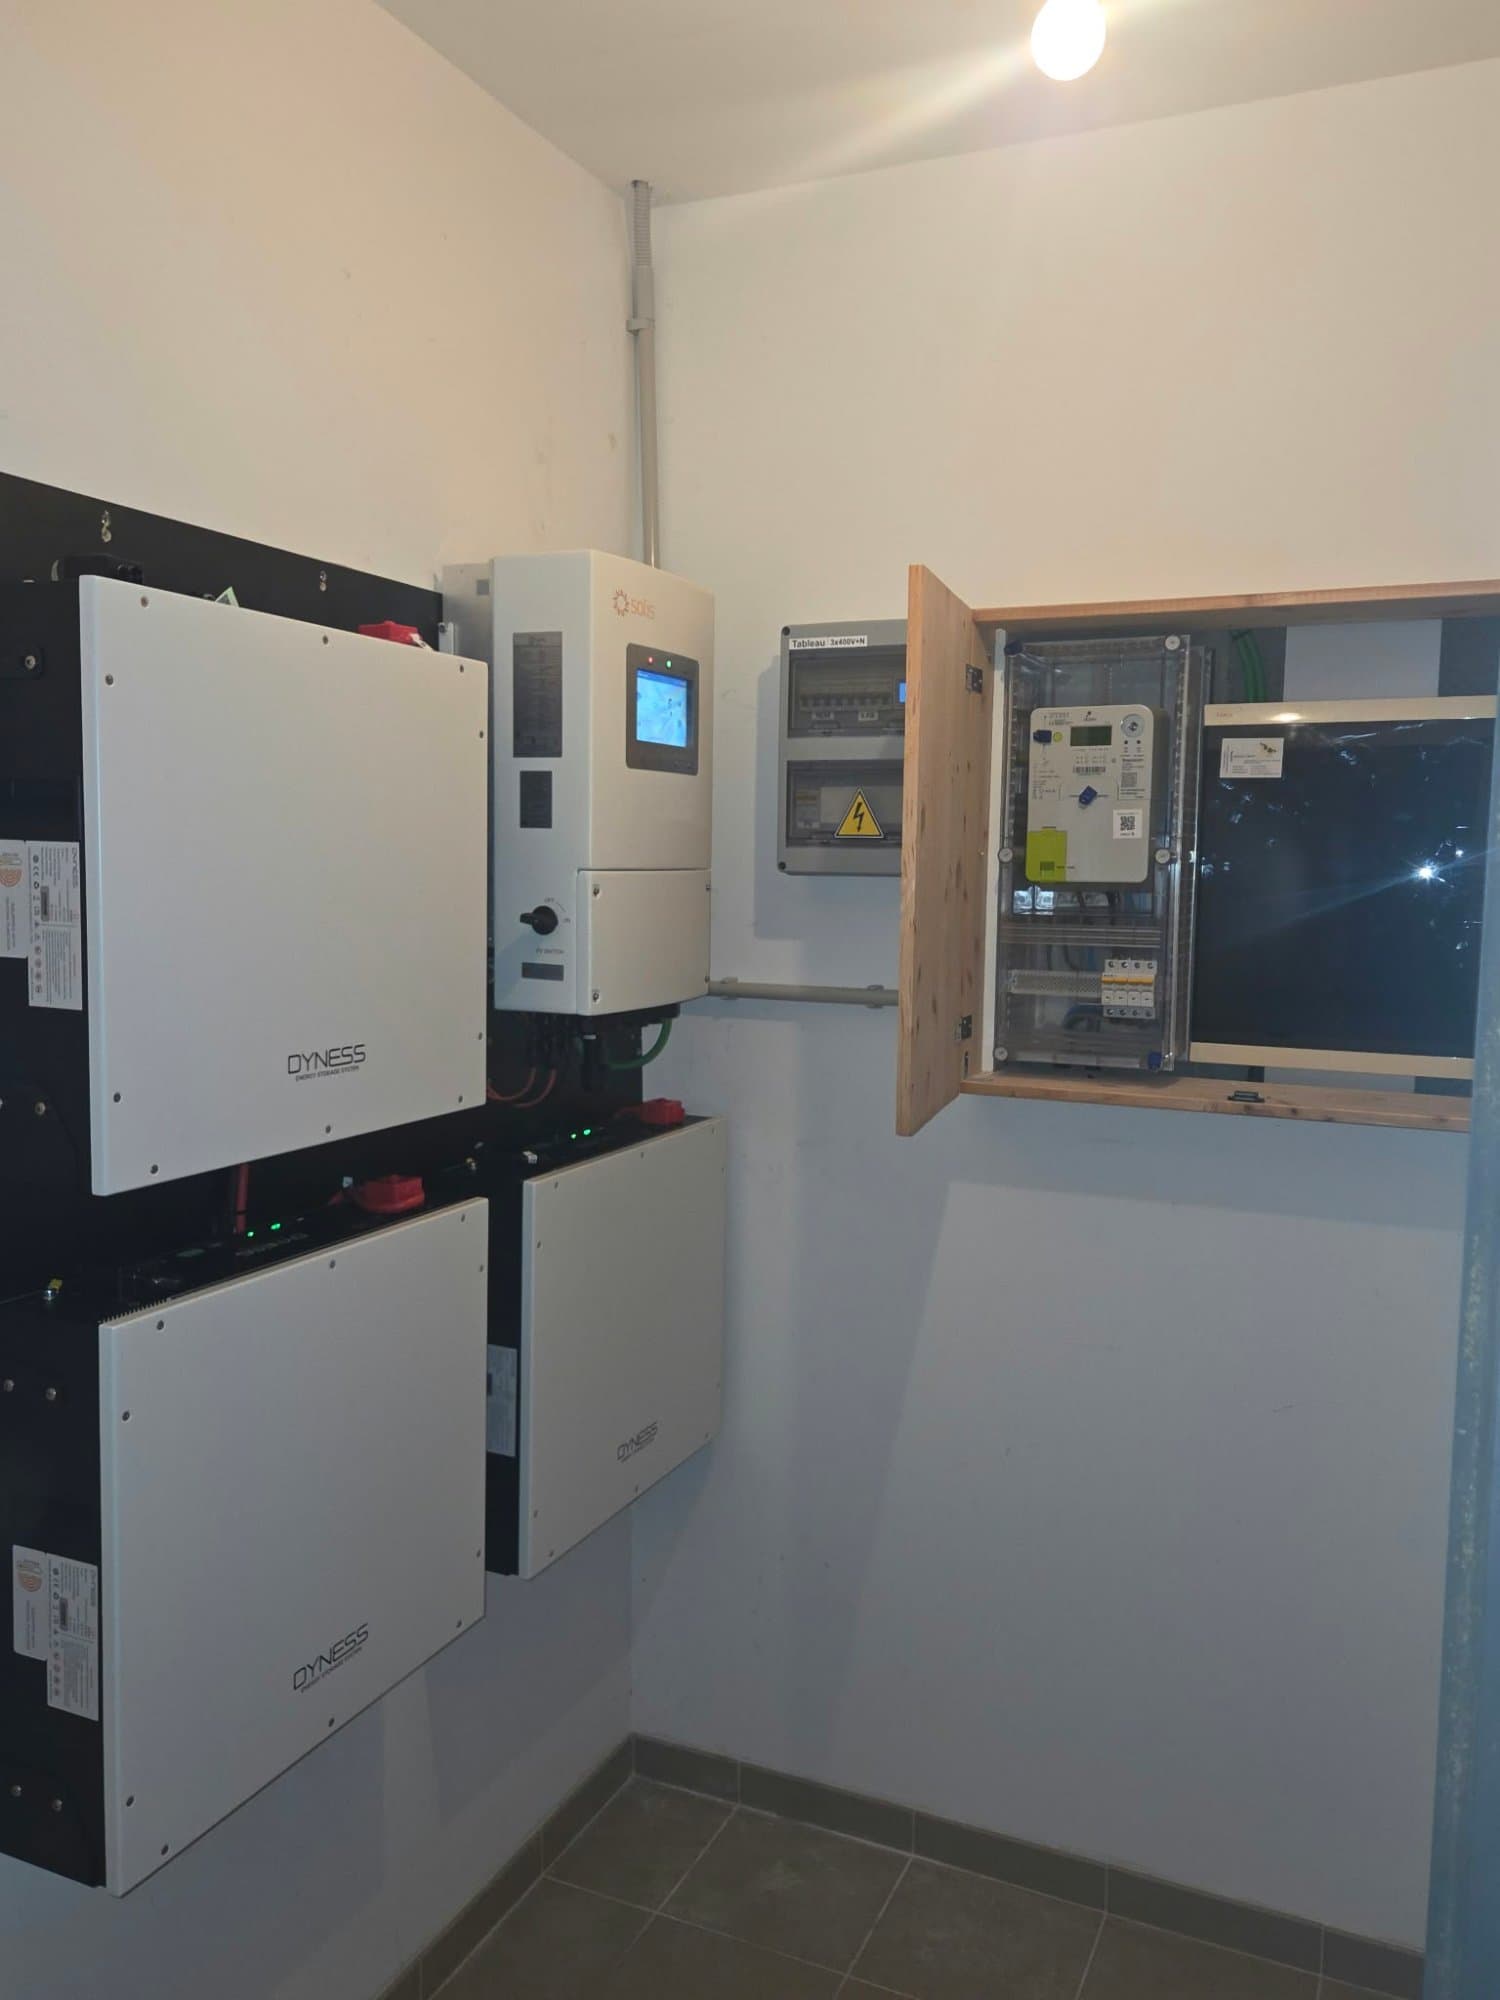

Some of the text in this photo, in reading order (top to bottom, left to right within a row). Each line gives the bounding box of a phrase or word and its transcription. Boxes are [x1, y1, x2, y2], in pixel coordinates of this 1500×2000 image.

[631, 598, 655, 619] solis
[792, 639, 826, 649] Tableau
[288, 1044, 366, 1074] DYNESS
[616, 1421, 658, 1461] DYNESS
[293, 1622, 369, 1691] DYNESS
